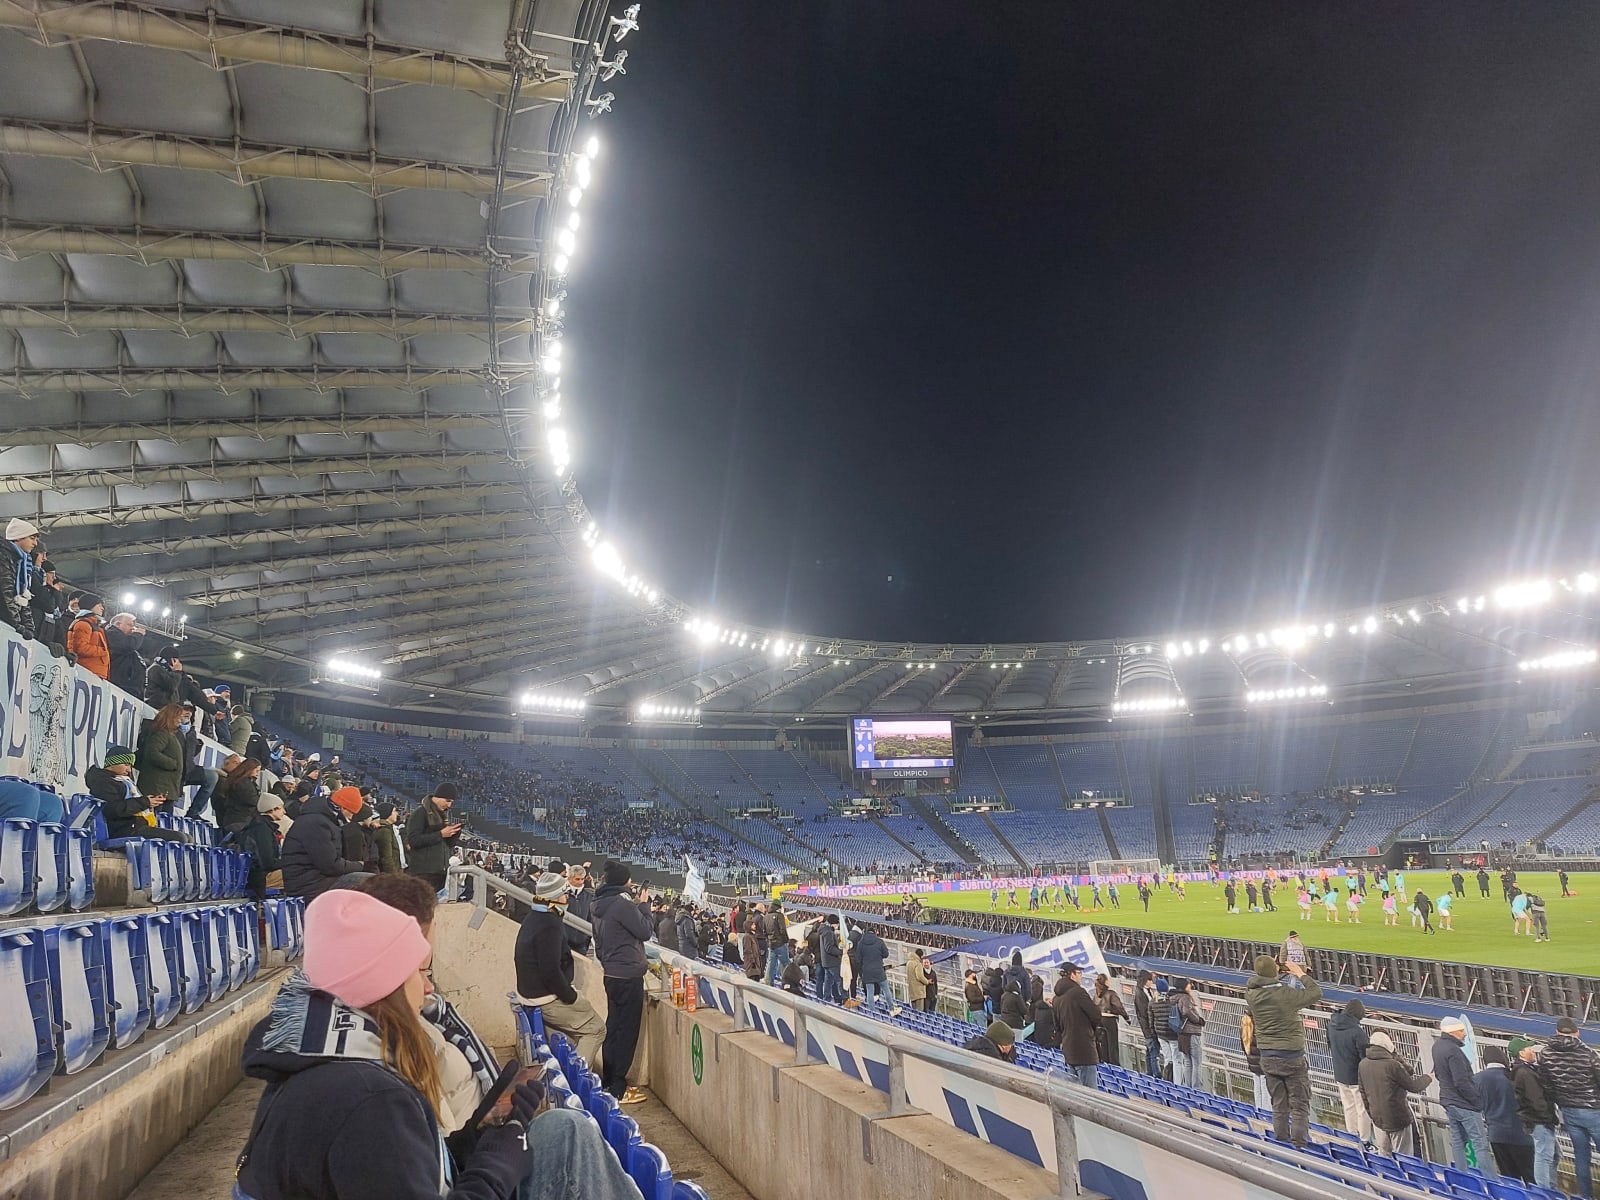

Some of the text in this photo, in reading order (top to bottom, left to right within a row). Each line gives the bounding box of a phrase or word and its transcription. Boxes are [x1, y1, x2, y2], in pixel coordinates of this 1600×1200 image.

[0, 639, 137, 777] E PRATI
[816, 883, 935, 898] SUBITO CONNESSI CON TIM
[960, 880, 991, 891] SUBITO
